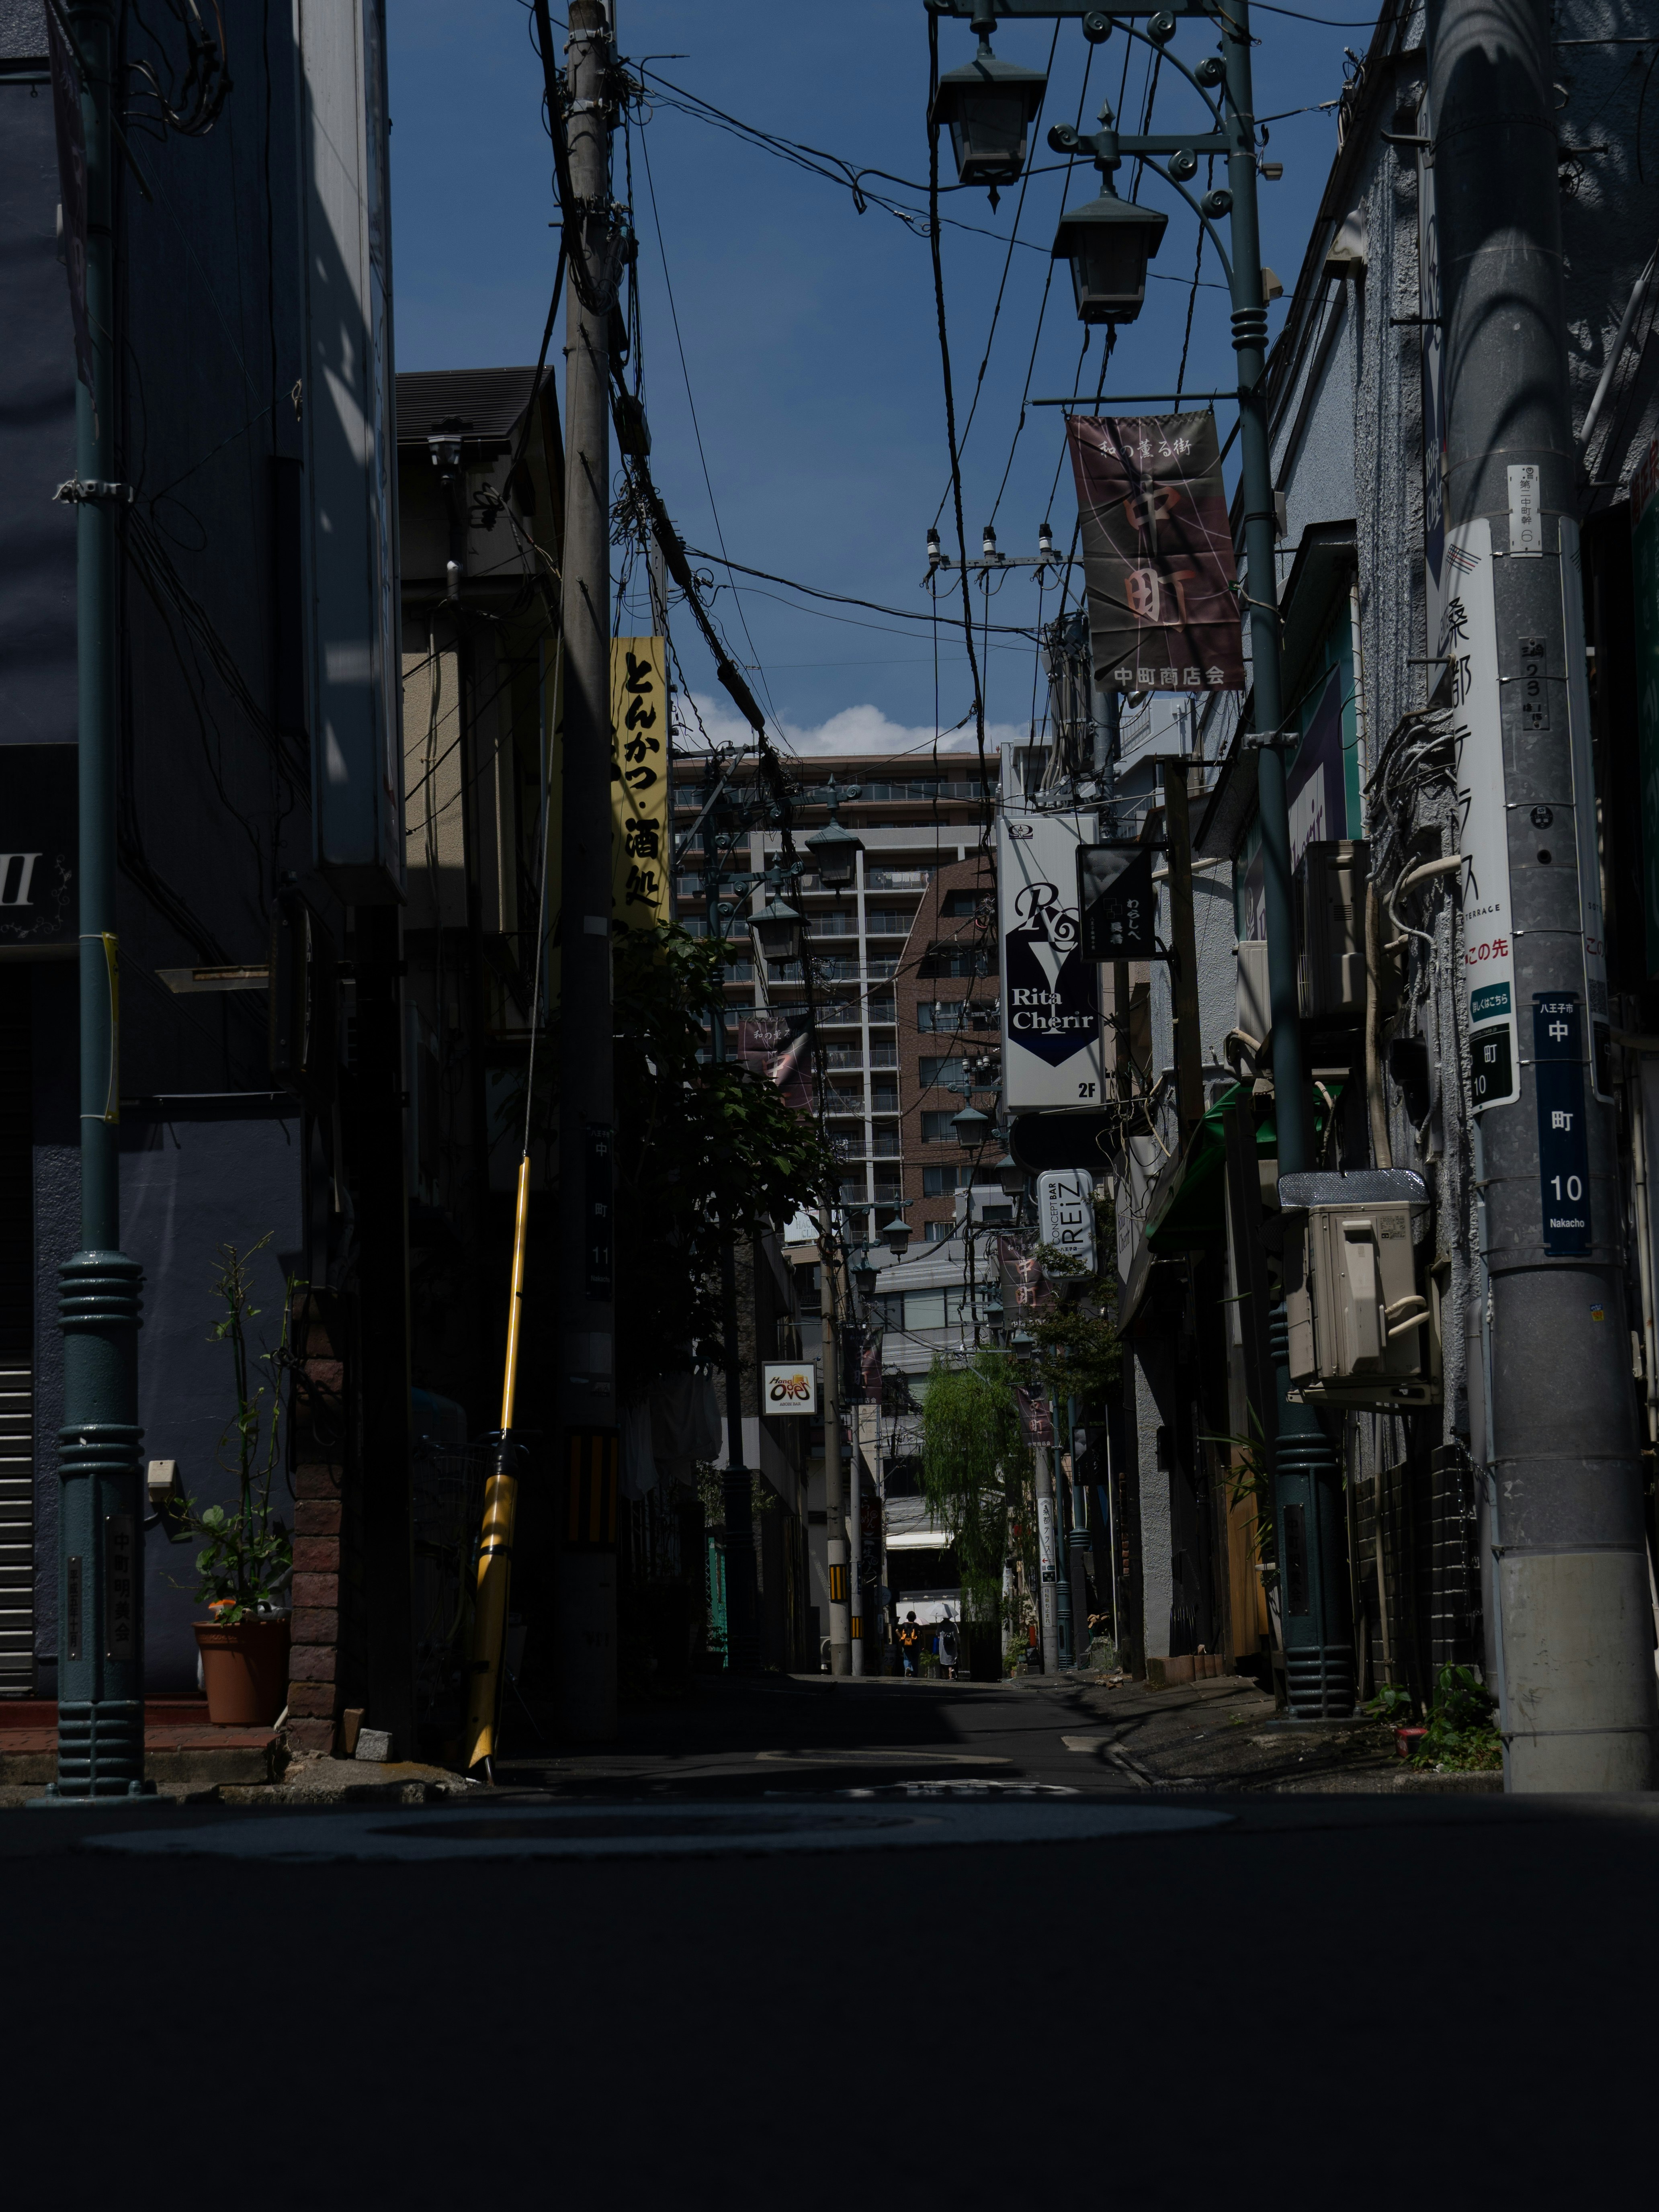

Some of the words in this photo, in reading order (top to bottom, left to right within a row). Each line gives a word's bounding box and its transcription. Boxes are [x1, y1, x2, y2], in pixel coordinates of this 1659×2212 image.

[1098, 438, 1192, 458] 和の薫る街
[1520, 480, 1531, 524] 第二中町幹
[1521, 530, 1532, 542] 6
[1123, 474, 1196, 633] 中町
[1114, 666, 1224, 686] 中町商店会
[1126, 899, 1141, 940] わらしべ
[1466, 904, 1500, 921] TERRACE
[1110, 922, 1124, 944] 長者
[1469, 939, 1508, 965] この先
[1012, 988, 1062, 1005] Rita
[1472, 993, 1508, 1013] 詳しくはこちら
[1540, 1004, 1573, 1013] 八王子市
[1013, 1011, 1093, 1029] Cherir
[1079, 1083, 1095, 1098] 2F
[1550, 1176, 1582, 1201] 10
[1050, 1202, 1060, 1245] CONCEPT
[1550, 1218, 1585, 1228] Nakacho
[592, 1246, 608, 1264] 11
[591, 1275, 610, 1283] Nakacho
[115, 1532, 129, 1641] 中町明美会
[70, 1570, 78, 1647] 平成五年十一月
